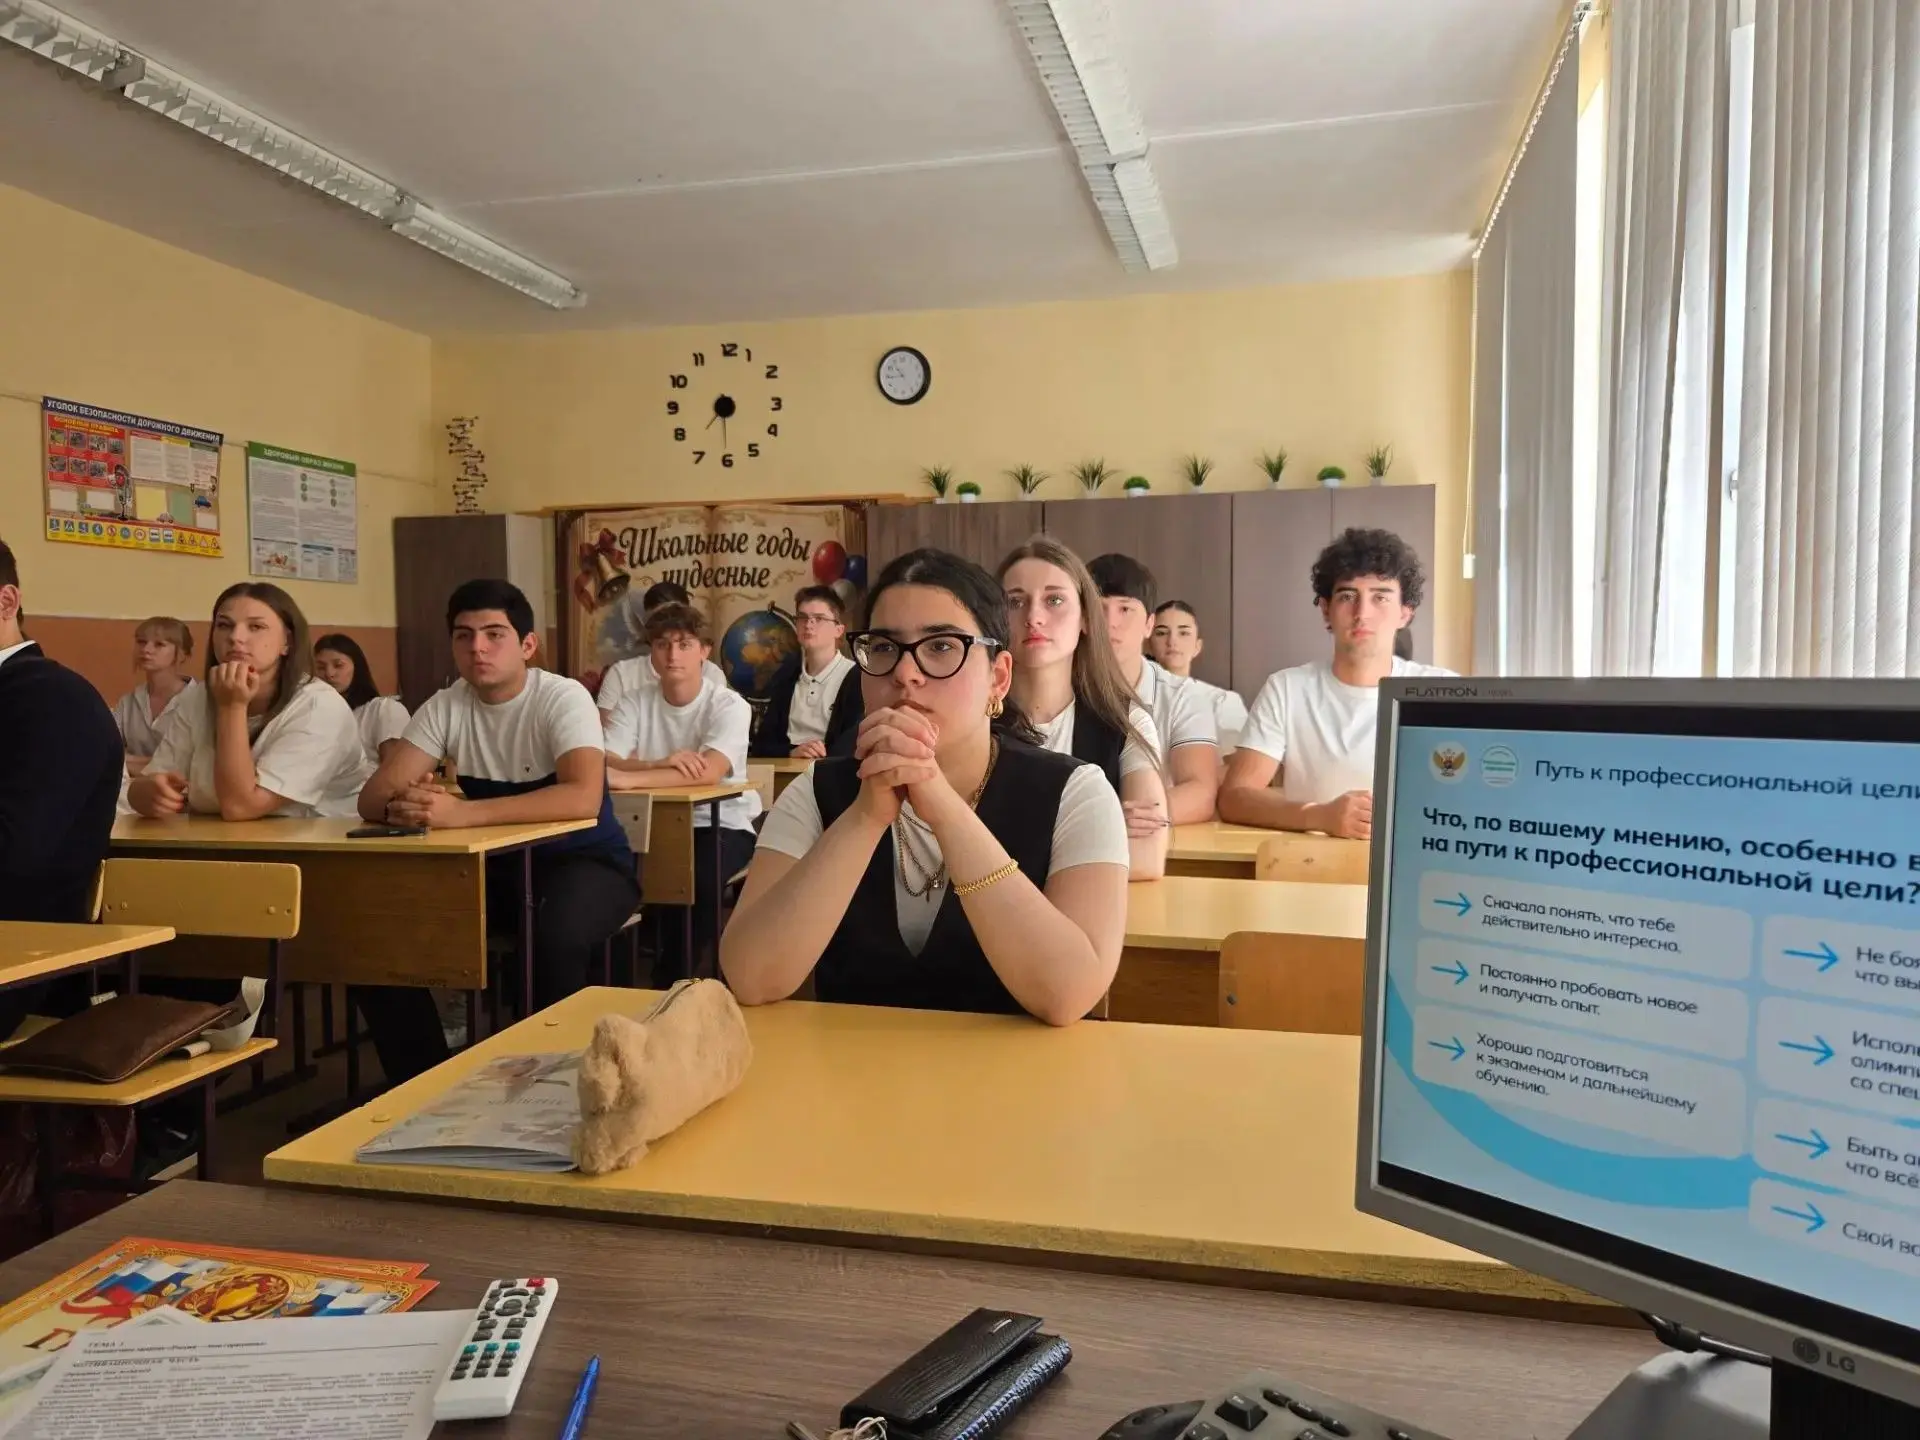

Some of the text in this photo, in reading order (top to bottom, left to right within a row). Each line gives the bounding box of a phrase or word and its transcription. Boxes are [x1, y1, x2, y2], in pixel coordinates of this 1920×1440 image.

[721, 343, 738, 357] 12
[745, 348, 752, 362] 1
[692, 352, 704, 367] 11
[765, 365, 778, 379] 2
[669, 374, 688, 389] 10
[667, 401, 679, 415] 9
[771, 397, 782, 411] 3
[47, 399, 220, 443] УГОЛОК БЕЗОПАСНОСТИ ДОРОЖНОГО ДВИЖЕНИЯ
[674, 427, 686, 442] 8
[767, 423, 778, 437] 4
[692, 451, 706, 465] 7
[747, 443, 759, 457] 5
[721, 453, 734, 468] 6
[619, 526, 812, 568] Школьные годы
[1405, 686, 1478, 697] FLATRON
[1535, 760, 1584, 781] Путь
[1591, 767, 1603, 780] к
[1609, 766, 1853, 796] профессиональной
[1423, 806, 1467, 831] Что,
[1474, 815, 1502, 831] по
[1509, 818, 1606, 846] вашему
[1613, 825, 1731, 856] мнению,
[1741, 839, 1897, 869] особенно
[1422, 836, 1920, 905] на пути к профессиональной цели?
[1483, 894, 1676, 933] Сначала понять, что тебе
[1482, 913, 1590, 939] действительно
[1856, 946, 1885, 964] Не
[1855, 969, 1889, 986] что
[1480, 964, 1698, 1014] Постоянно пробовать новое
[1479, 983, 1600, 1016] и получать опыт.
[1476, 1032, 1649, 1081] Хорошо подготовиться
[1475, 1068, 1550, 1096] обучению.
[1476, 1053, 1698, 1114] к экзаменам и дальнейшему
[1850, 1076, 1873, 1091] со
[1847, 1136, 1898, 1162] Быть
[1846, 1161, 1879, 1178] что
[1842, 1222, 1894, 1250] Свой
[1826, 1351, 1856, 1374] LG
